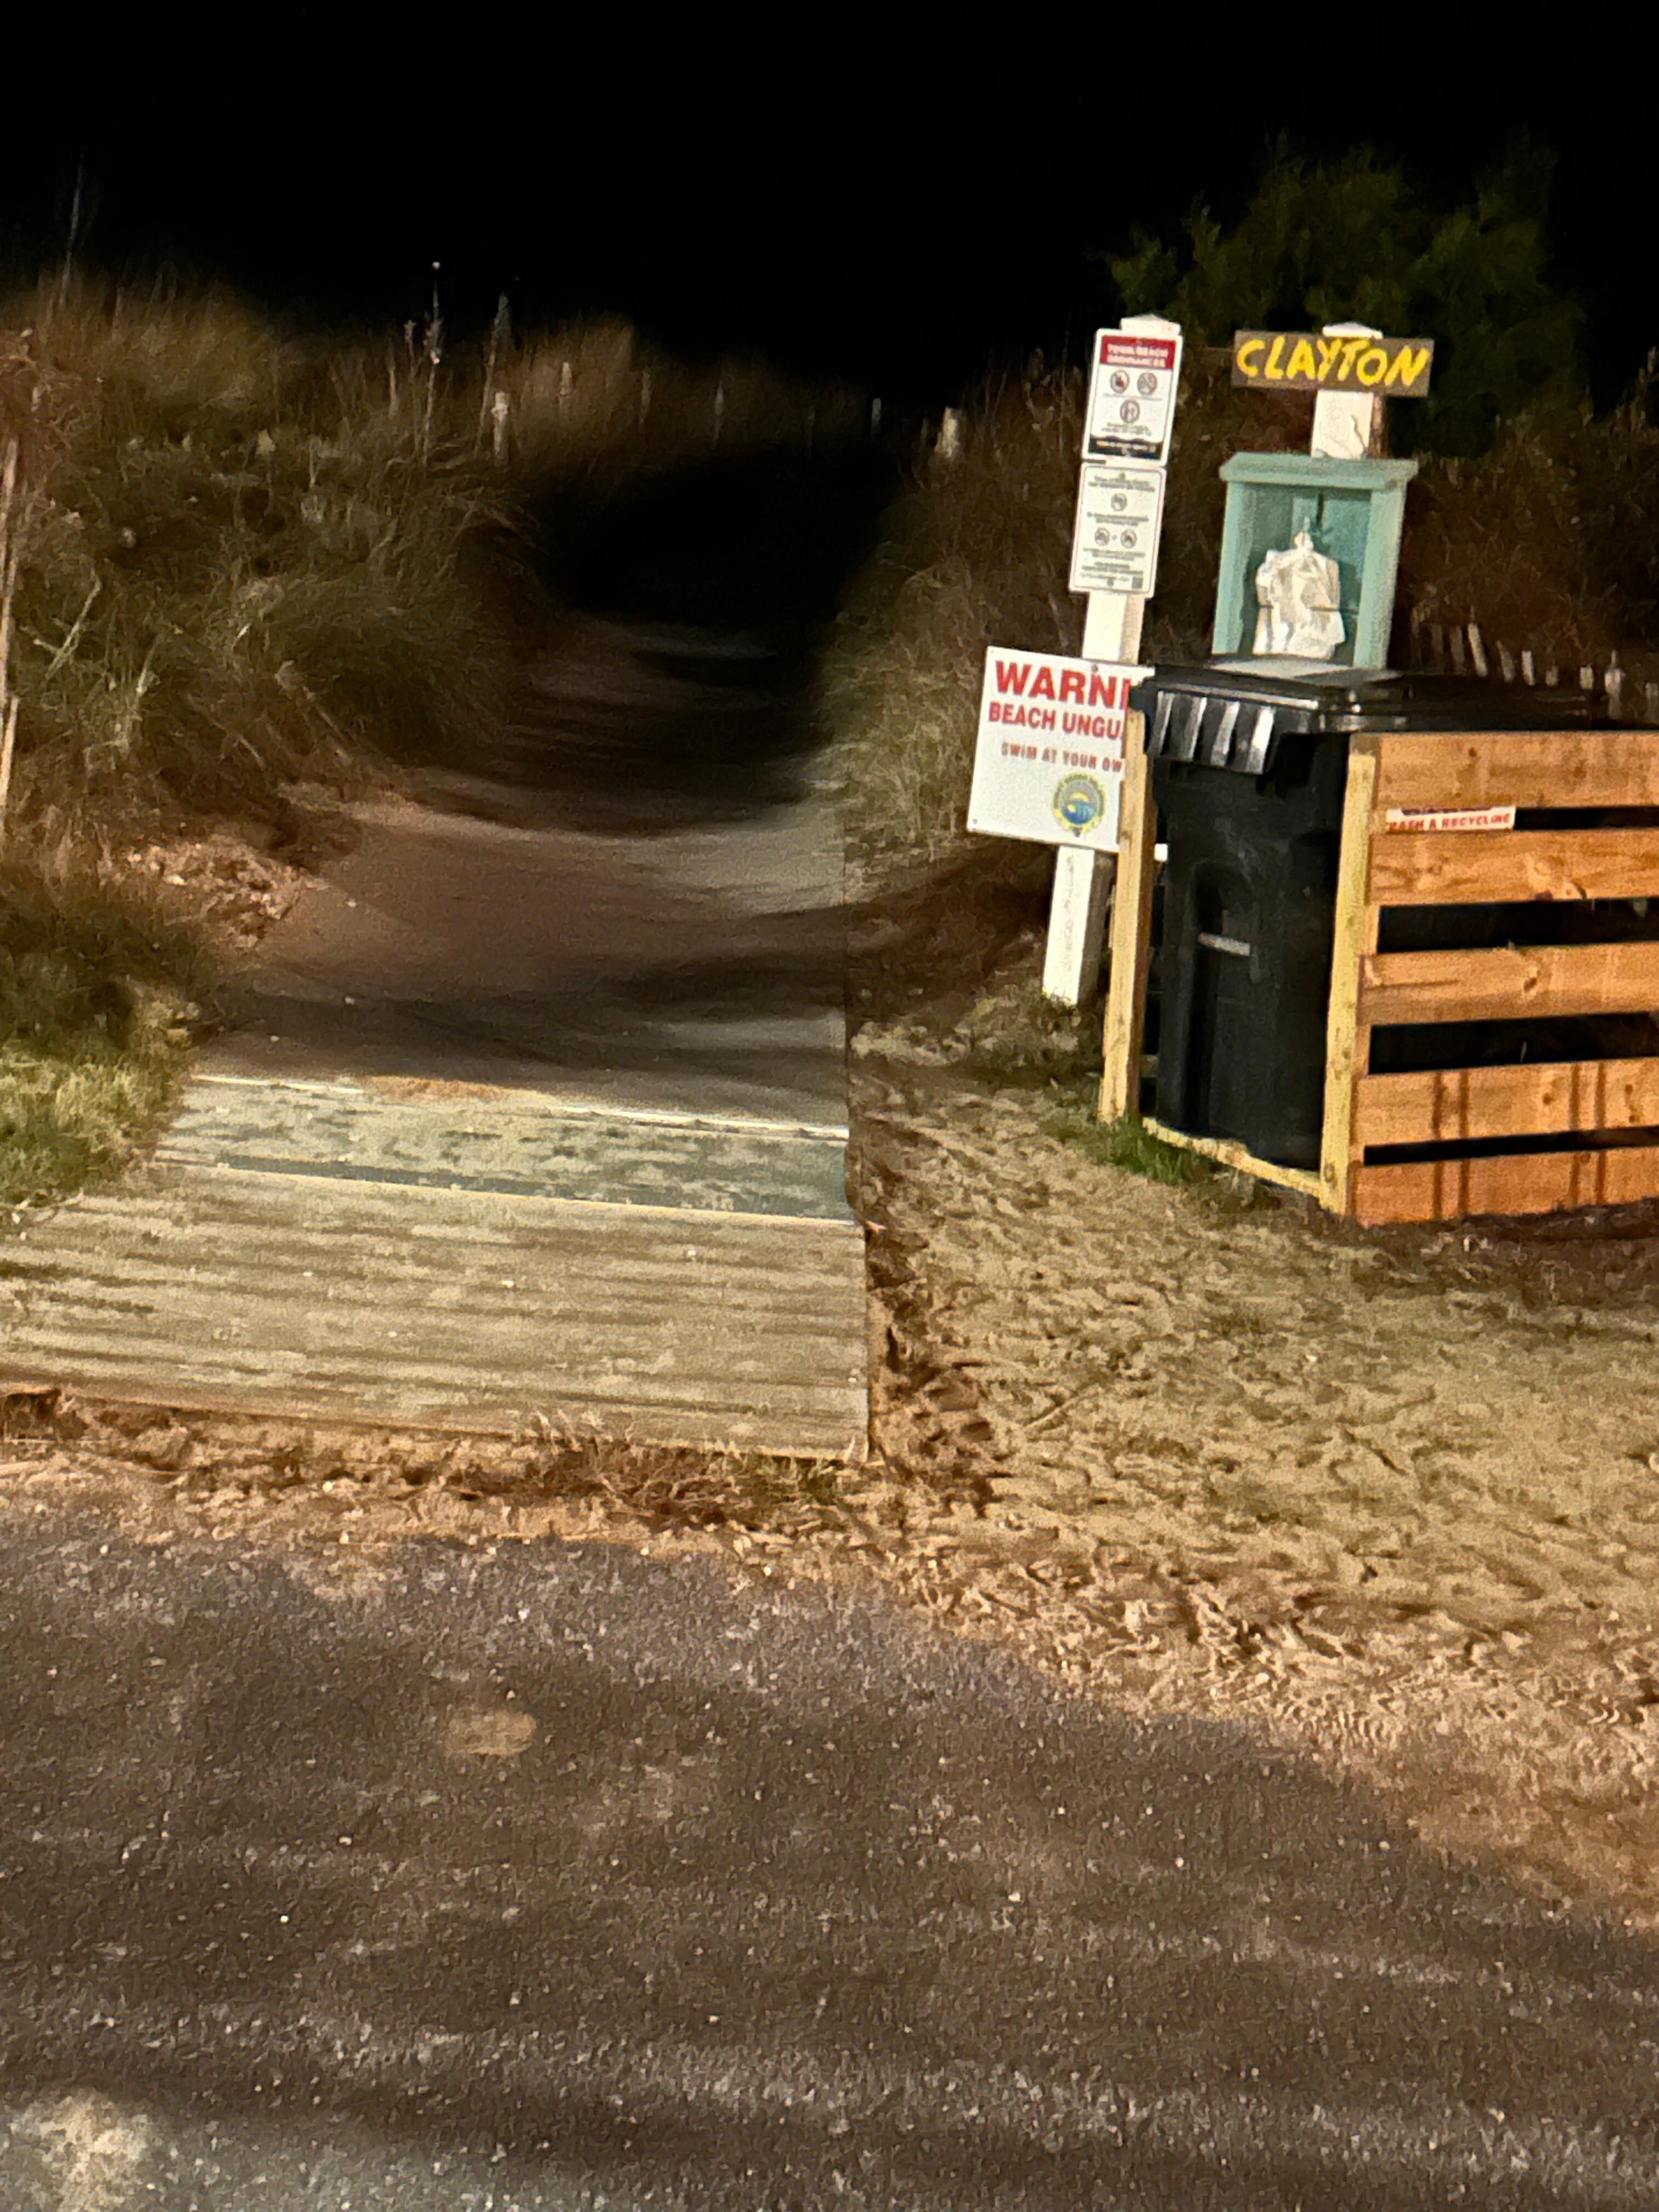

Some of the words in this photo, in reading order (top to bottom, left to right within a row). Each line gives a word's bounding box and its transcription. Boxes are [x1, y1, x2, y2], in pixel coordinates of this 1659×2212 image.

[1236, 336, 1430, 387] CLAYTON
[989, 701, 1057, 731] BEACH
[1001, 742, 1038, 760] SWIM
[1042, 748, 1057, 764] AT
[1063, 751, 1097, 769] YOUR
